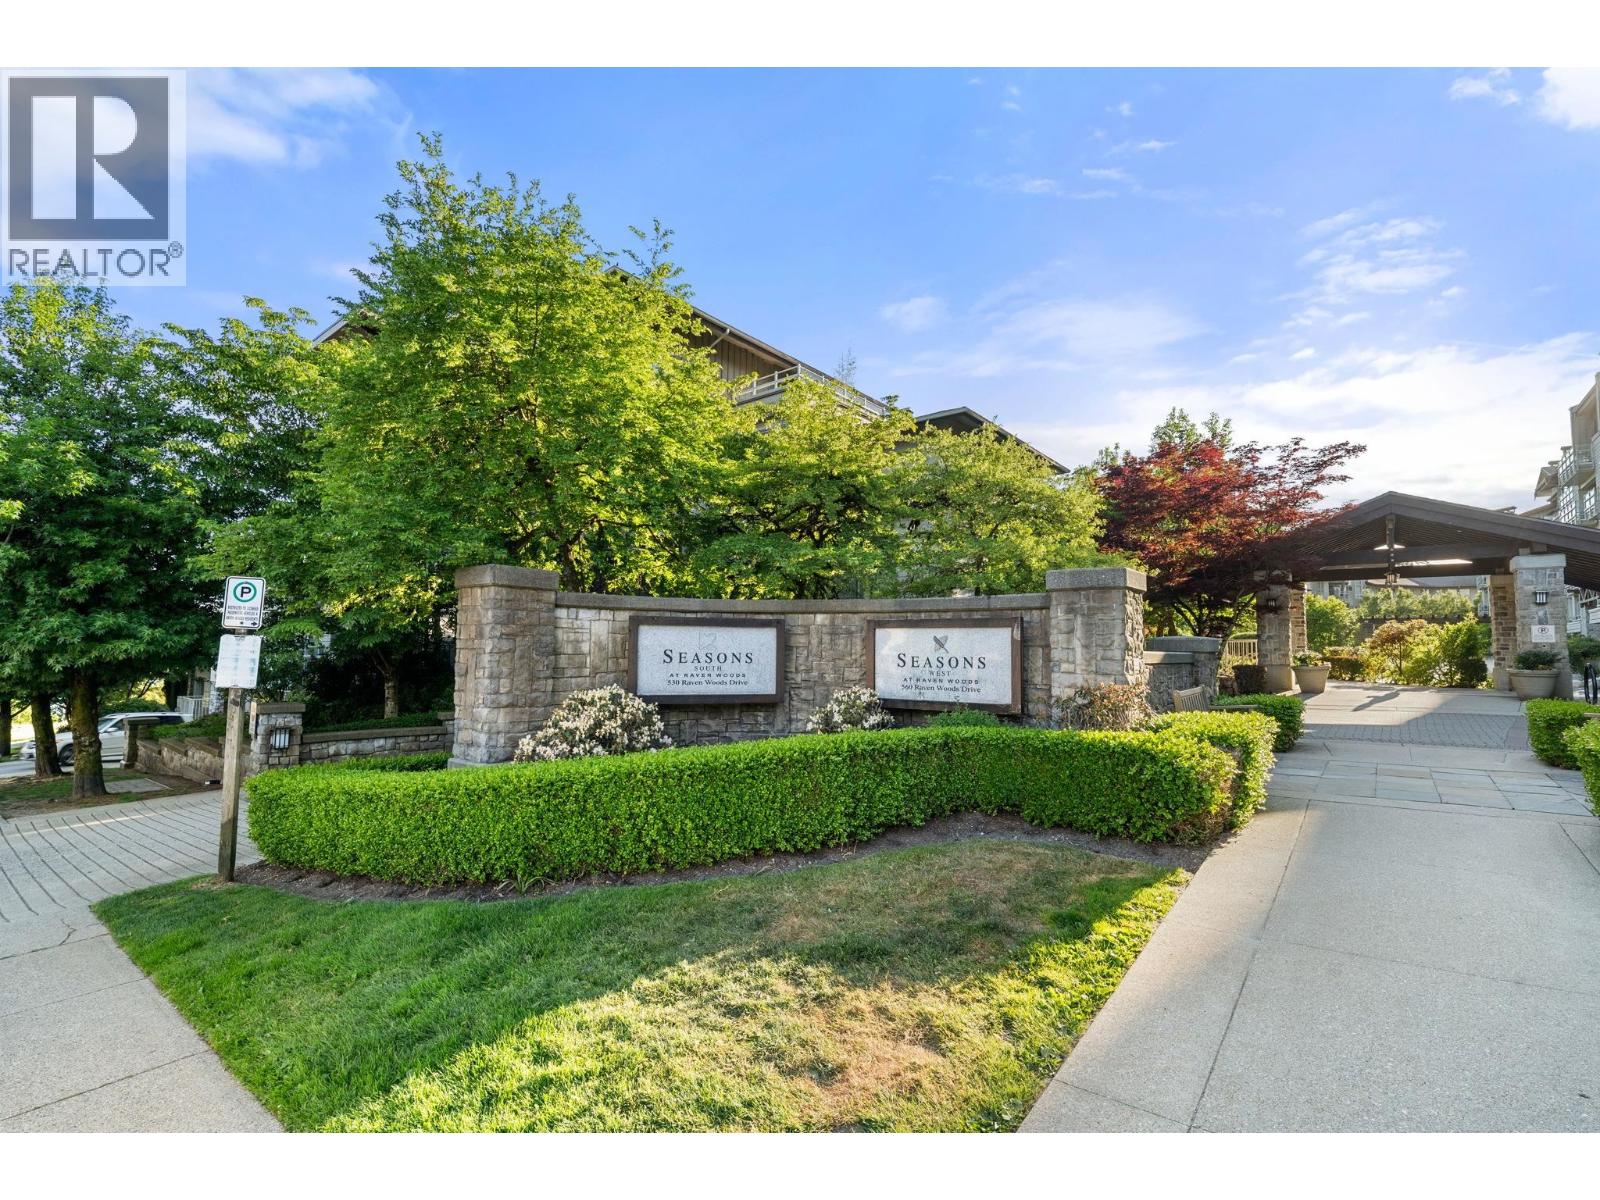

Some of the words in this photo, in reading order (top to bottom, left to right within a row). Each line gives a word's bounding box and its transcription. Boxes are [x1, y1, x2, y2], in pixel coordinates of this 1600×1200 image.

[240, 586, 252, 598] P
[663, 649, 754, 664] SEASONS
[897, 653, 986, 669] SEASONS
[961, 685, 982, 693] Drive
